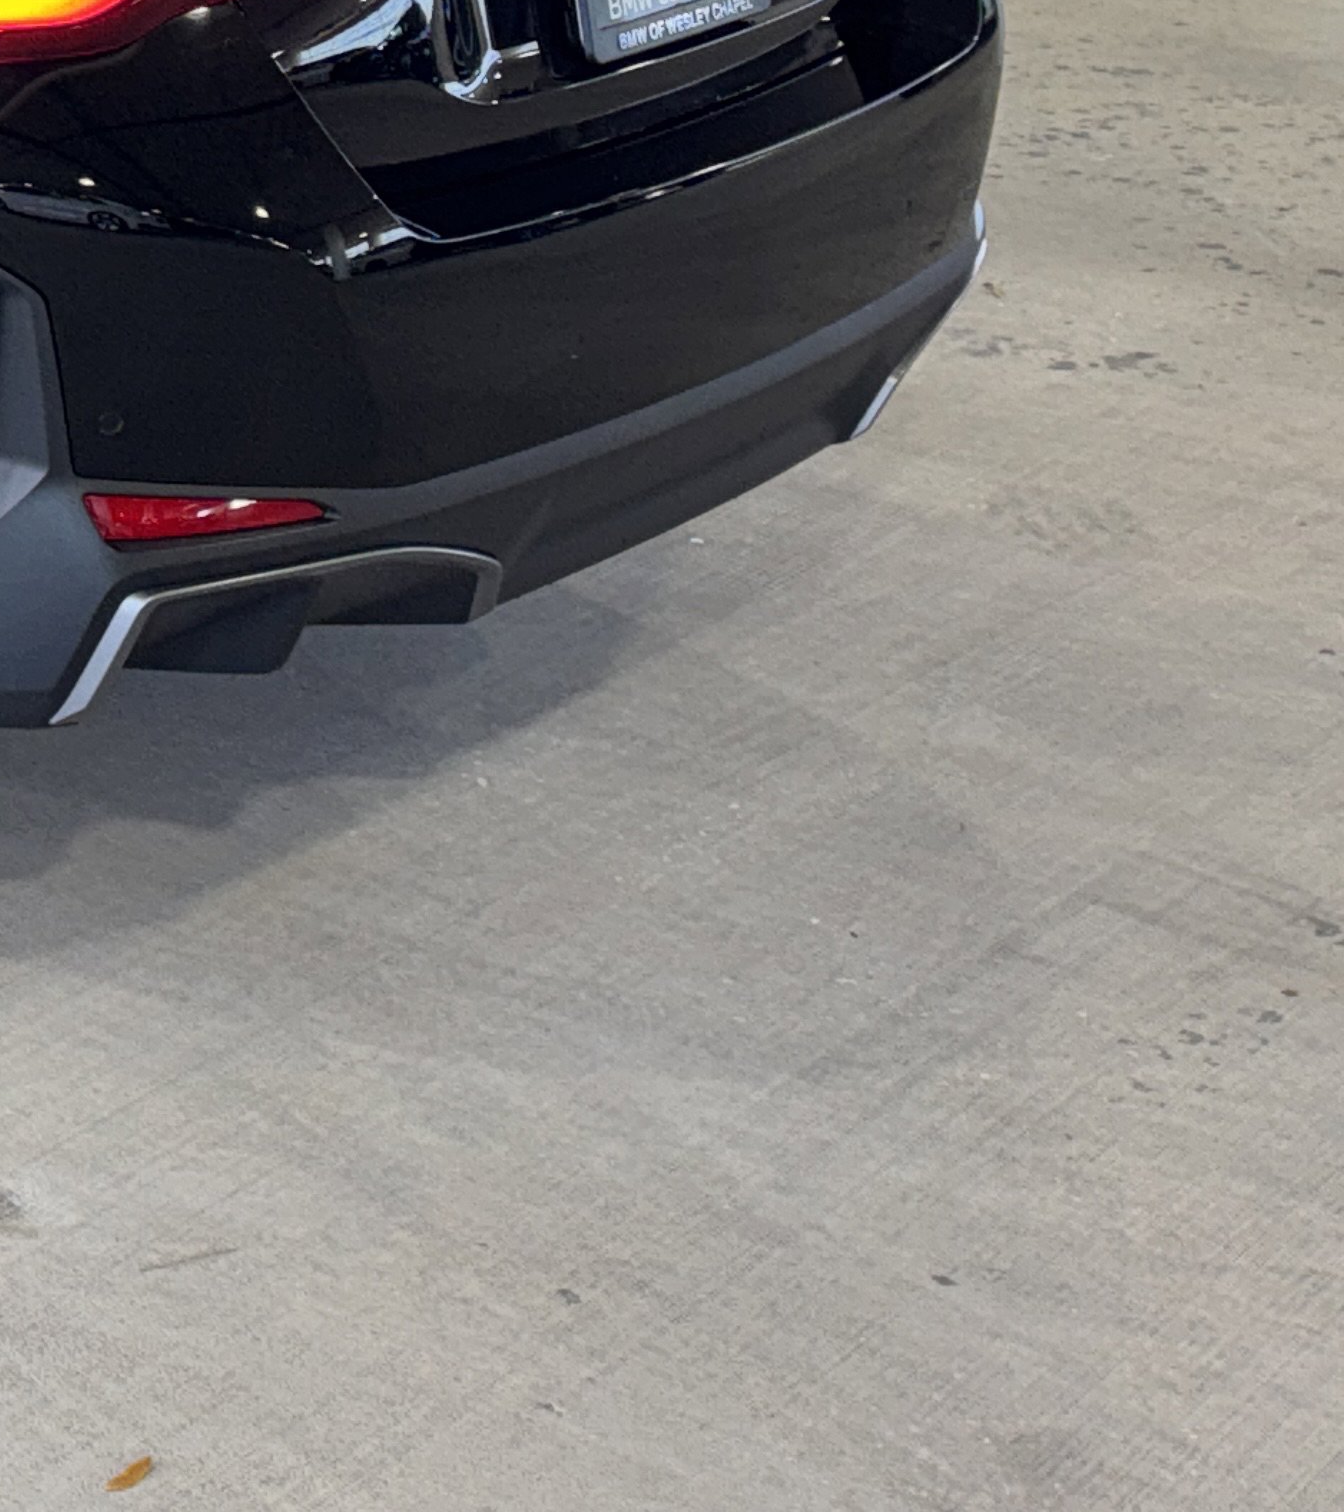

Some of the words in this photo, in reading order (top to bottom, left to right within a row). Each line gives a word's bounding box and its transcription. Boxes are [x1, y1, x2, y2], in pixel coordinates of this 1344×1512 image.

[618, 26, 647, 50] BMW
[648, 19, 666, 40] OF
[665, 4, 710, 35] WESLEY
